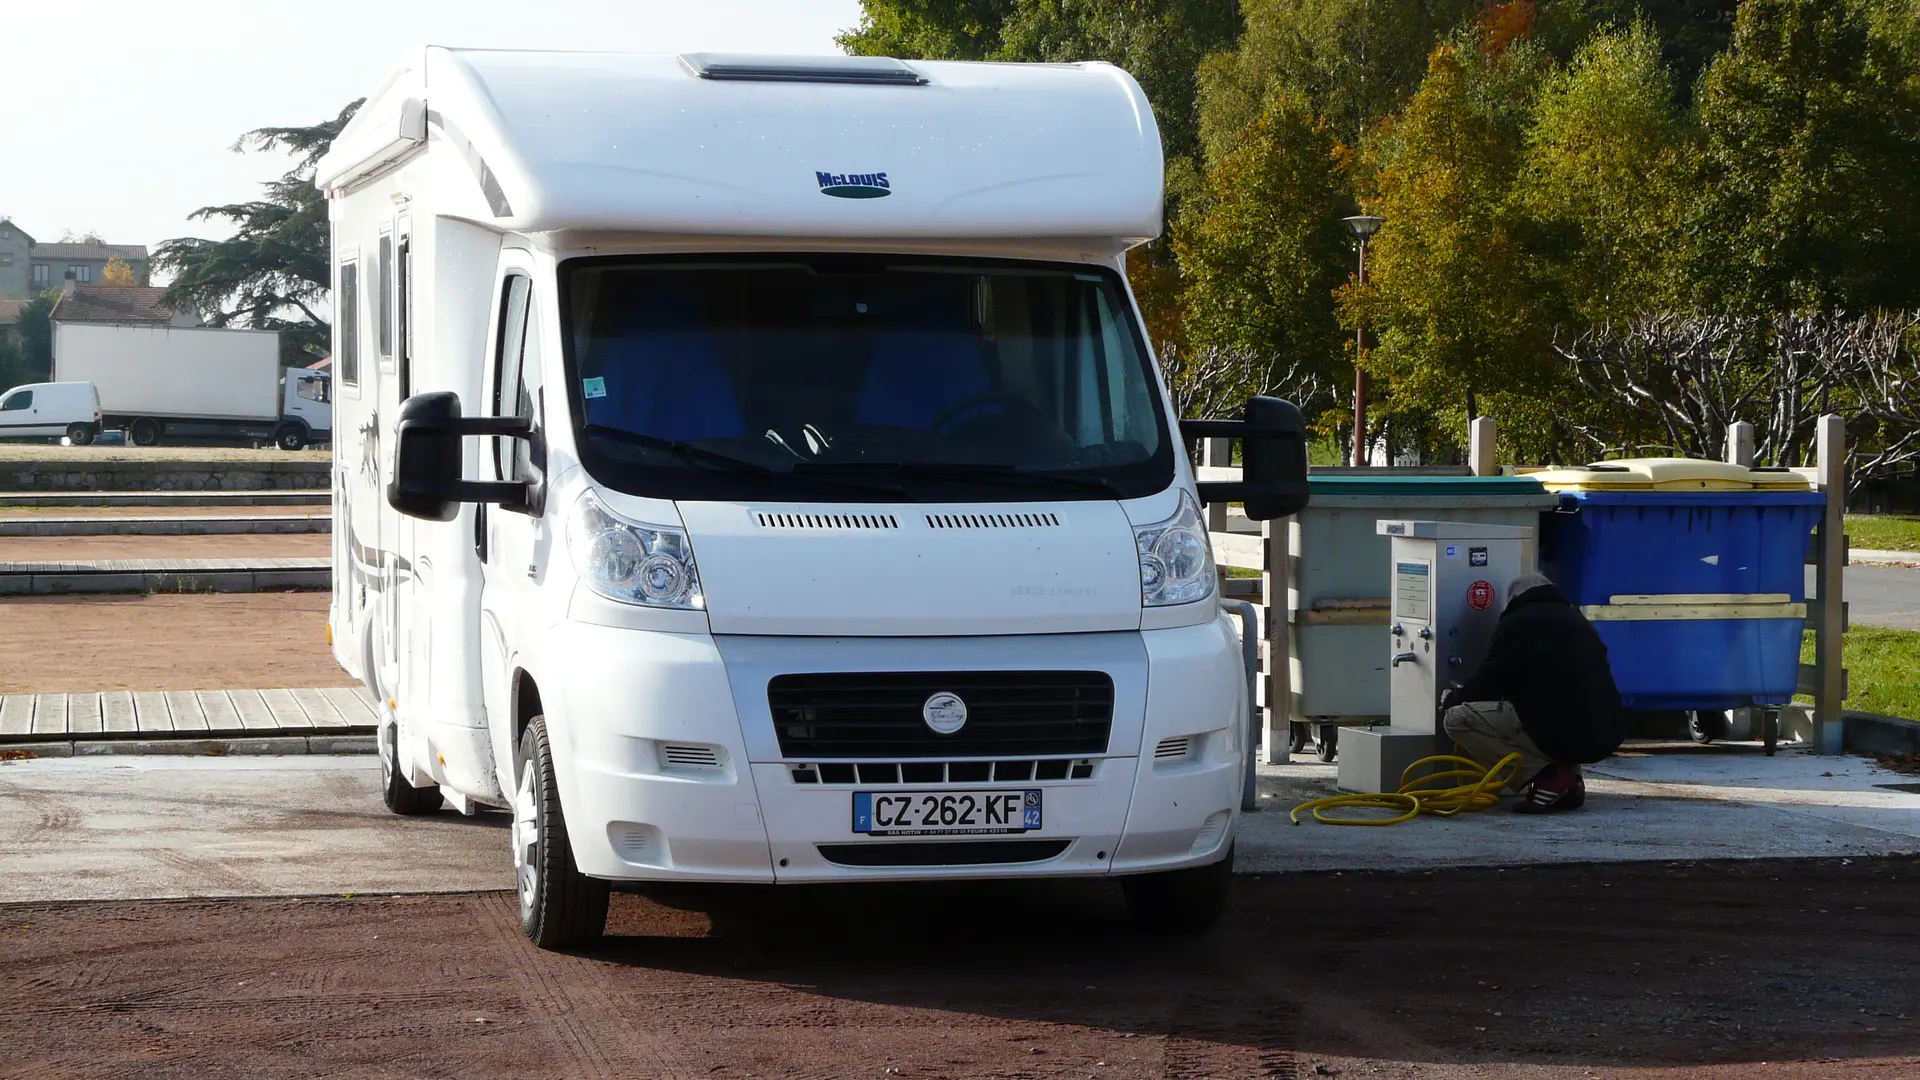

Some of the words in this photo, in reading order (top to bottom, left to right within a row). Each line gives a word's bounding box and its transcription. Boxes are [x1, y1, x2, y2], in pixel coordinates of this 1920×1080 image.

[875, 795, 1021, 827] CZ-262-KF
[1024, 810, 1040, 826] 42
[859, 815, 866, 825] F
